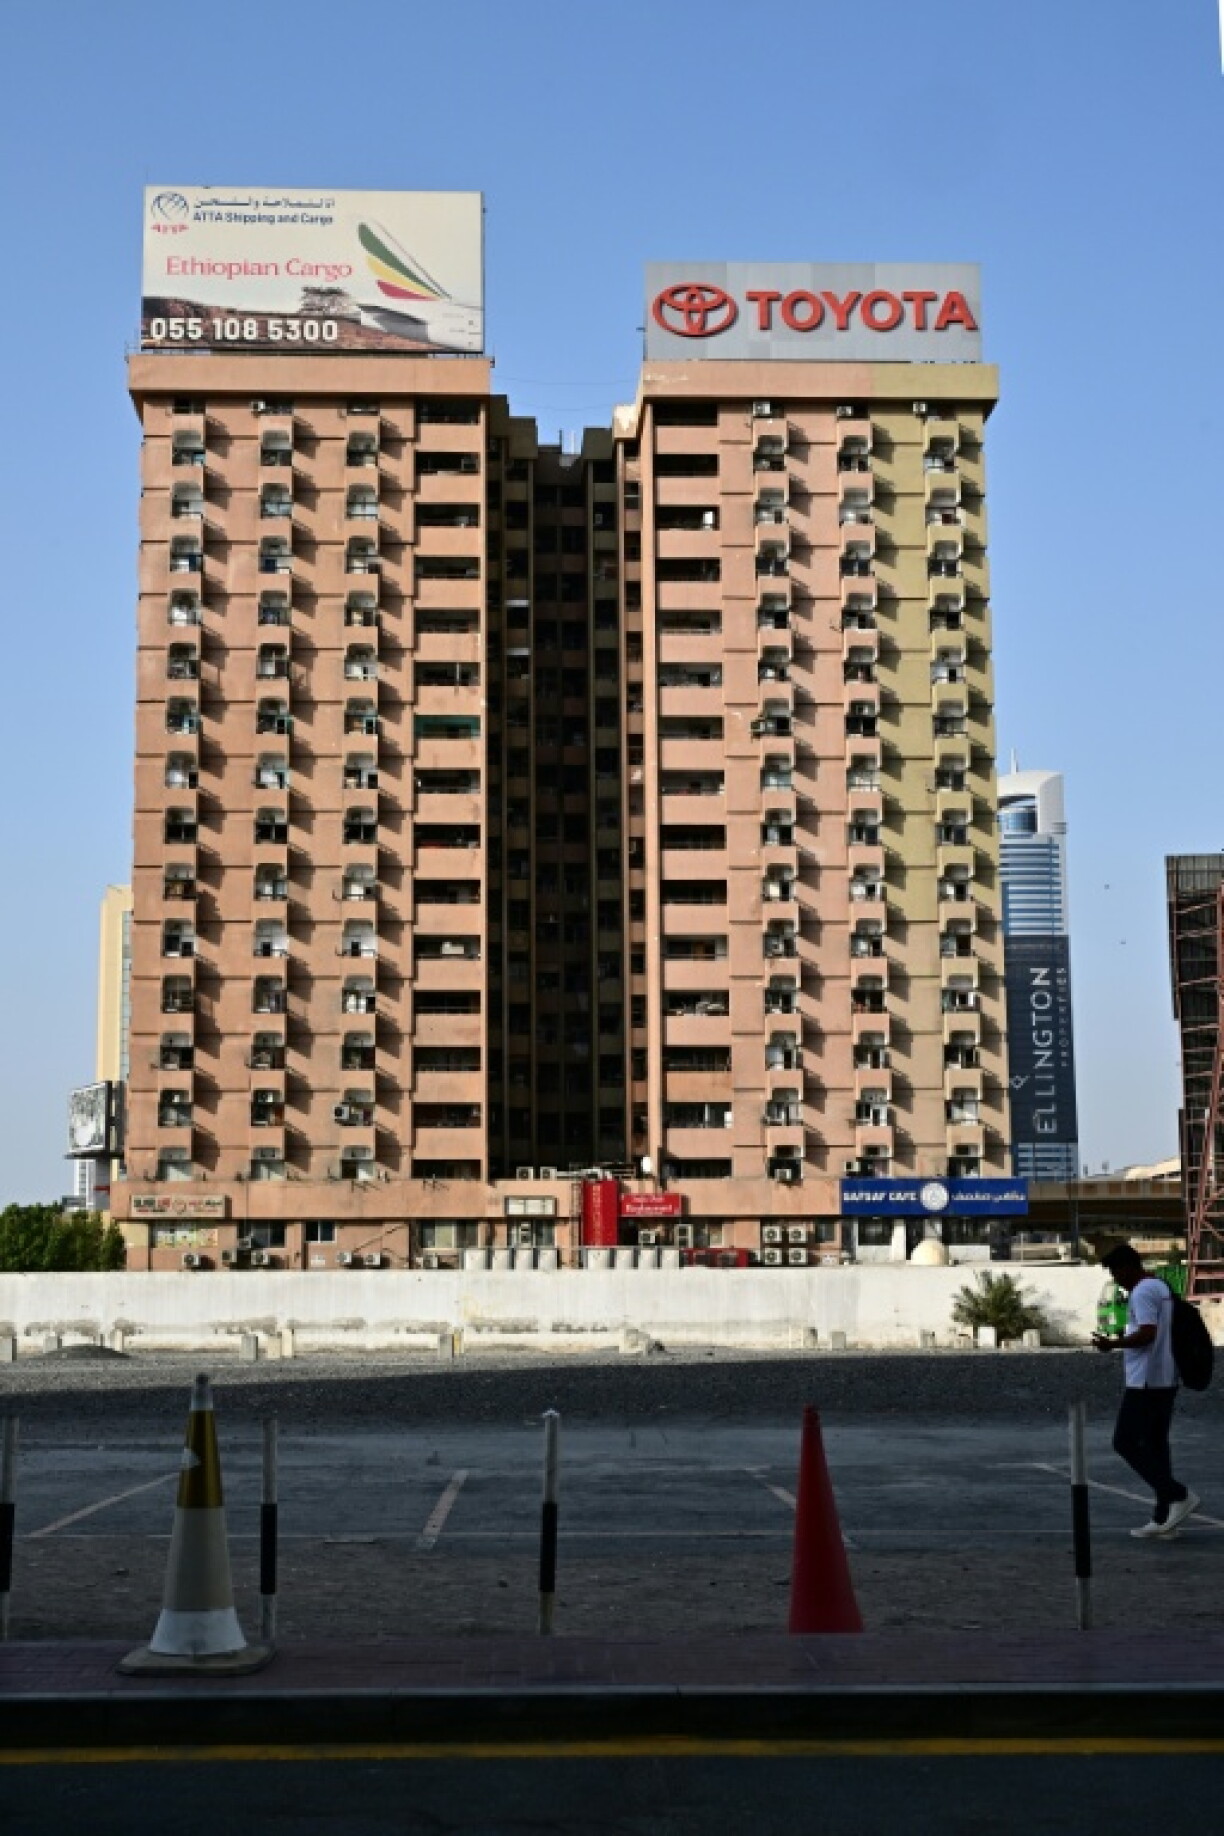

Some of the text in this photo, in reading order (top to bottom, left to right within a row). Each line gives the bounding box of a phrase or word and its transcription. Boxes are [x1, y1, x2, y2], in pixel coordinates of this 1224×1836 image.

[193, 212, 333, 225] ATTA Shipping and Cargo
[166, 256, 353, 282] Ethiopian Cargo
[745, 289, 979, 333] TOYOTA
[151, 318, 338, 341] 055 108 5300
[1029, 967, 1058, 1134] ELLINGTON
